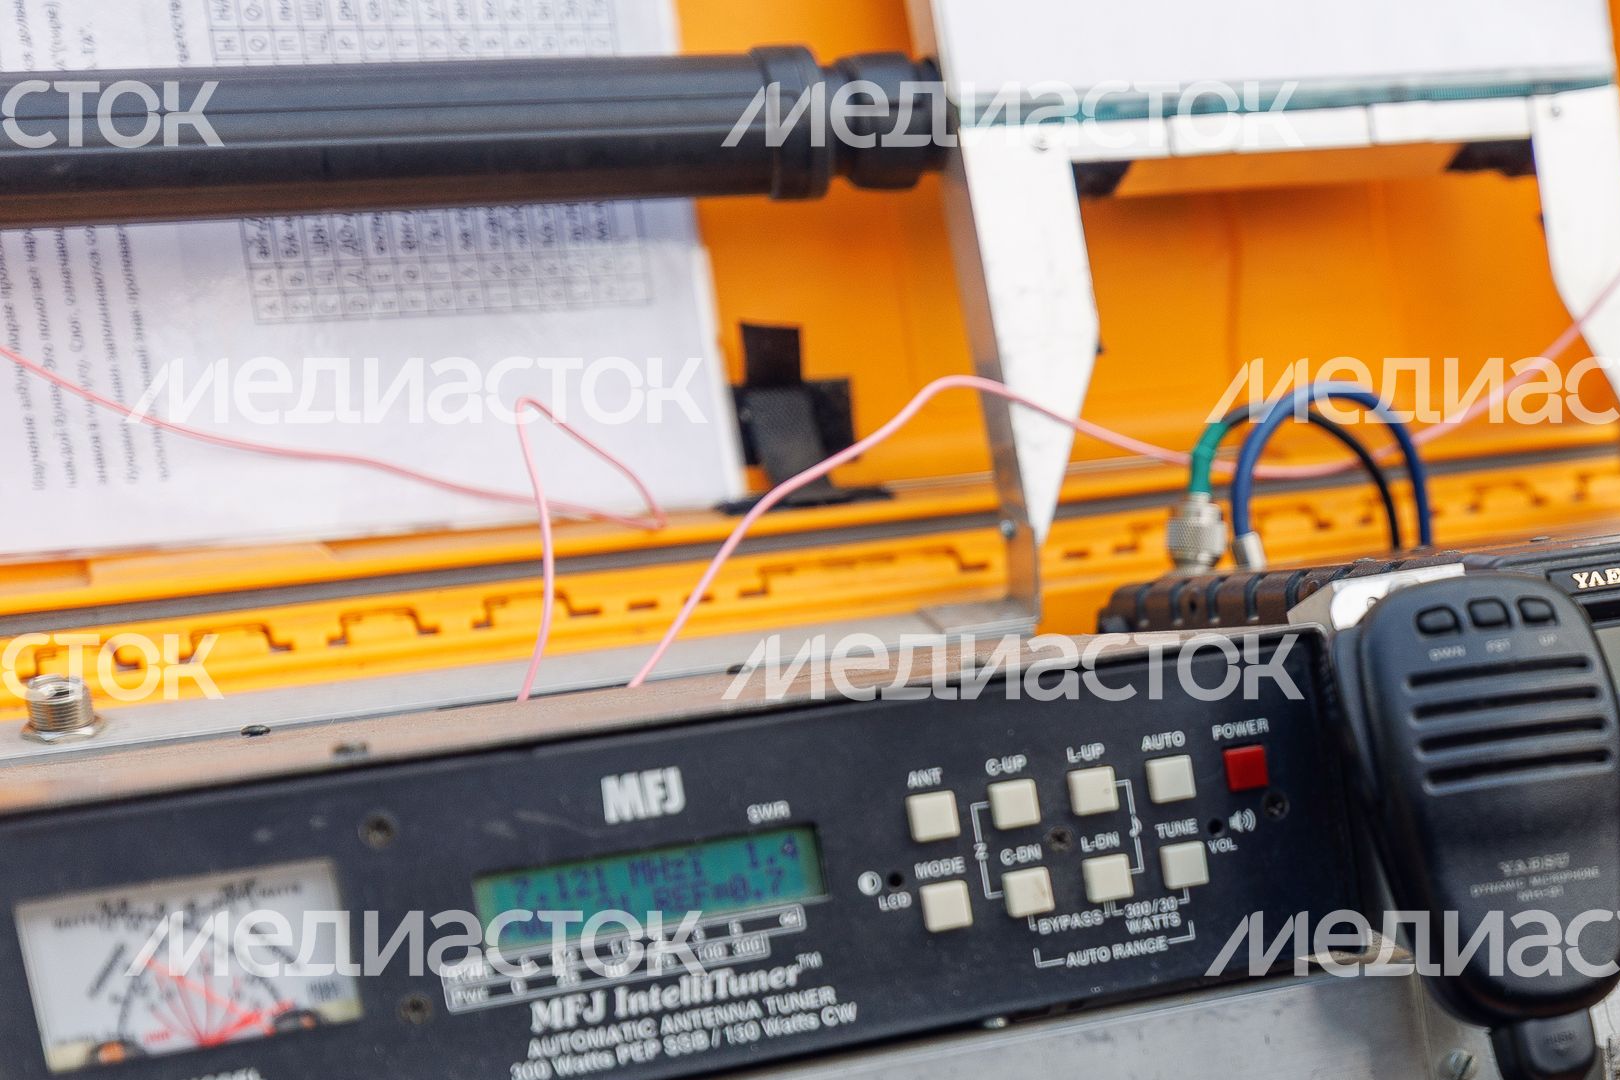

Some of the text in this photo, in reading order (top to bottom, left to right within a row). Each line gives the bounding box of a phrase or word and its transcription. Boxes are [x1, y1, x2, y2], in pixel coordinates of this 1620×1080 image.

[1141, 730, 1186, 752] AUTO
[1212, 718, 1270, 741] POWER
[1066, 743, 1105, 764] L-UP
[985, 754, 1027, 777] C-UP
[907, 767, 943, 790] ANT
[601, 766, 685, 825] MFJ
[747, 800, 791, 824] SWR
[1155, 818, 1199, 840] TUNE
[1081, 832, 1120, 853] L-DN
[1208, 838, 1238, 855] VOL
[1000, 844, 1042, 866] C-DN
[914, 856, 966, 880] MODE
[878, 892, 912, 911] LCD
[1124, 896, 1178, 920] 300/30
[1038, 910, 1105, 936] BYPASS
[1125, 912, 1182, 936] WATTS
[731, 936, 762, 957] 300
[1066, 935, 1170, 969] AUTO RANGE
[530, 986, 608, 1034] MFJ
[527, 985, 839, 1061] AUTOMATIC ANTENNA TUNER
[552, 1047, 616, 1078] Watts
[615, 1037, 663, 1066] PEP
[663, 1028, 711, 1057] SSB
[723, 1019, 759, 1046] 150
[760, 1008, 822, 1038] Watts
[821, 1002, 858, 1028] CW
